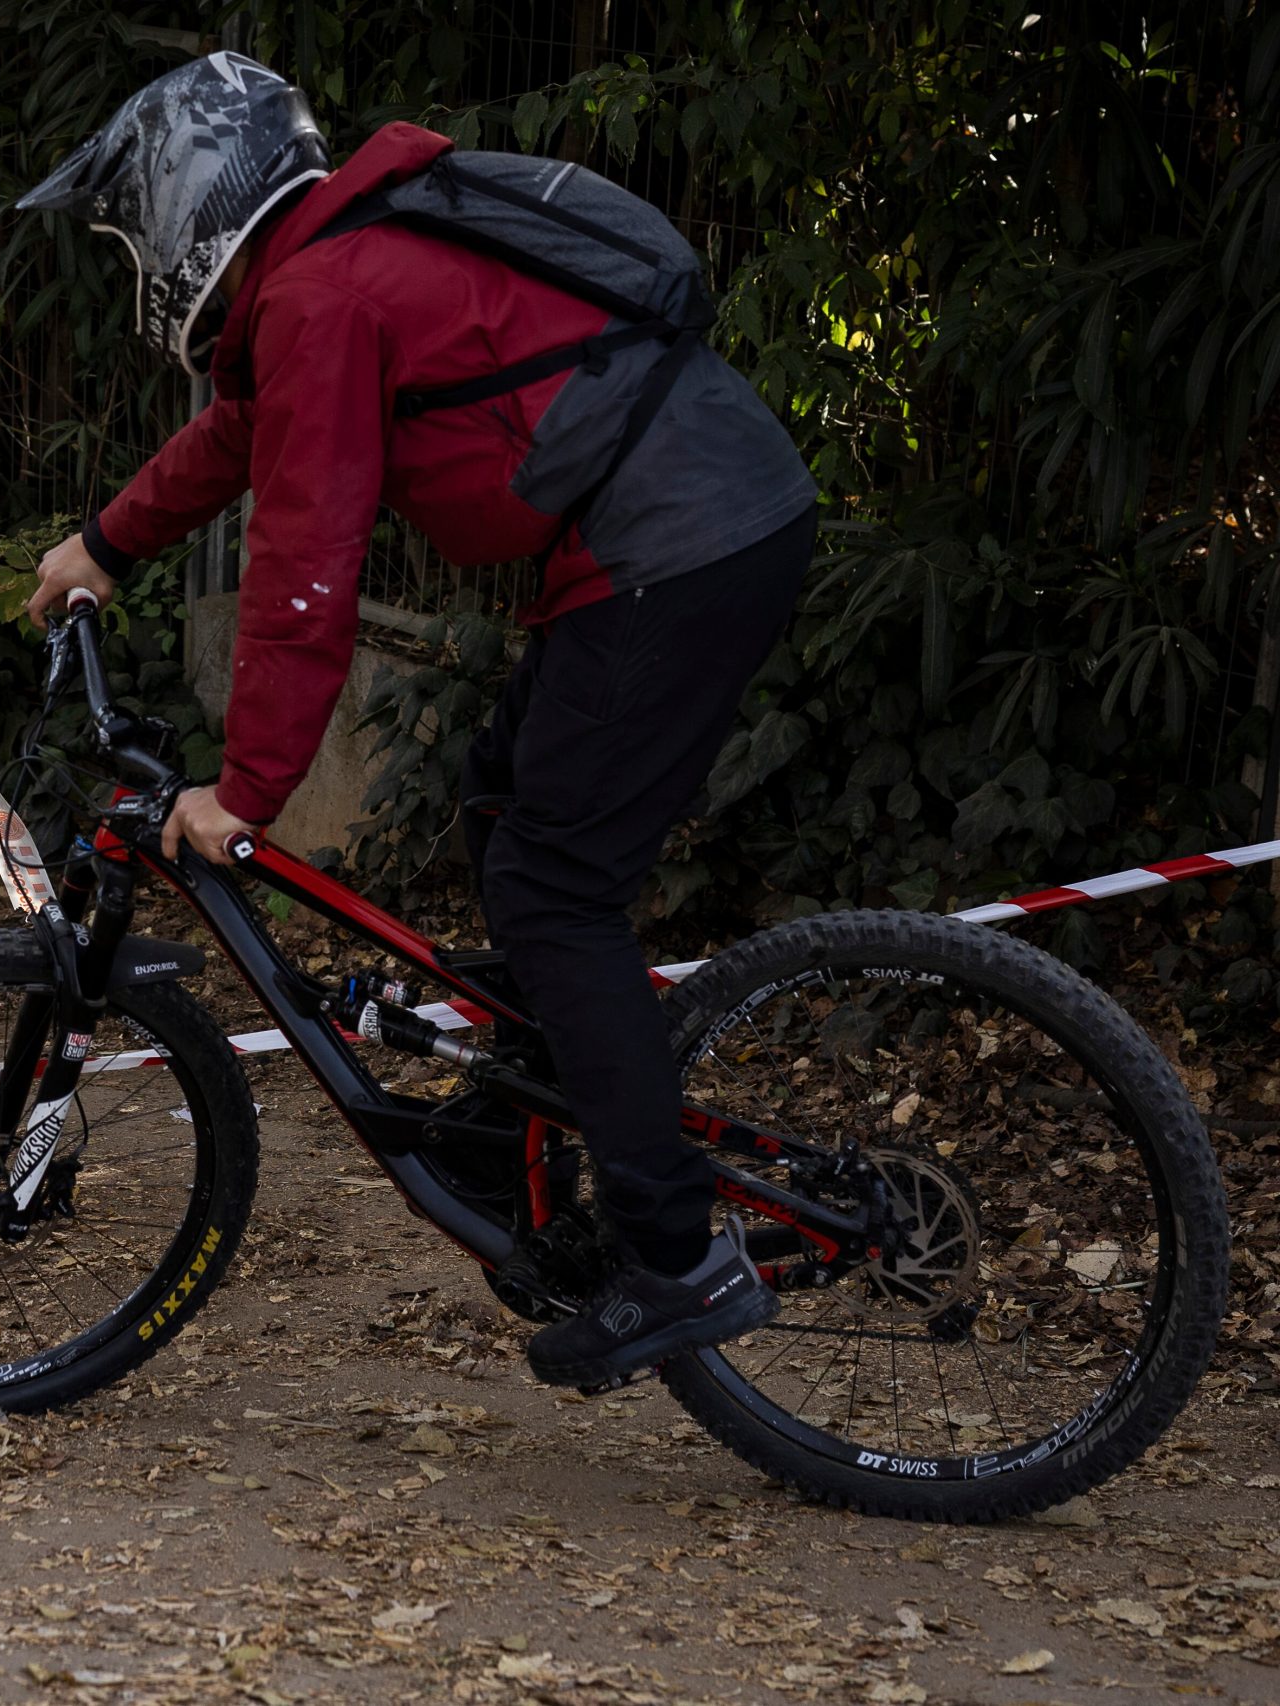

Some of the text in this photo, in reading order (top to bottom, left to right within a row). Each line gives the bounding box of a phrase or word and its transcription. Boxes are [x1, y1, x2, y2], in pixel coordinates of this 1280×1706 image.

[862, 968, 945, 985] DT SWISS
[138, 1225, 223, 1341] MAXXIS
[728, 1273, 744, 1287] TEN
[856, 1451, 938, 1477] DT SWISS
